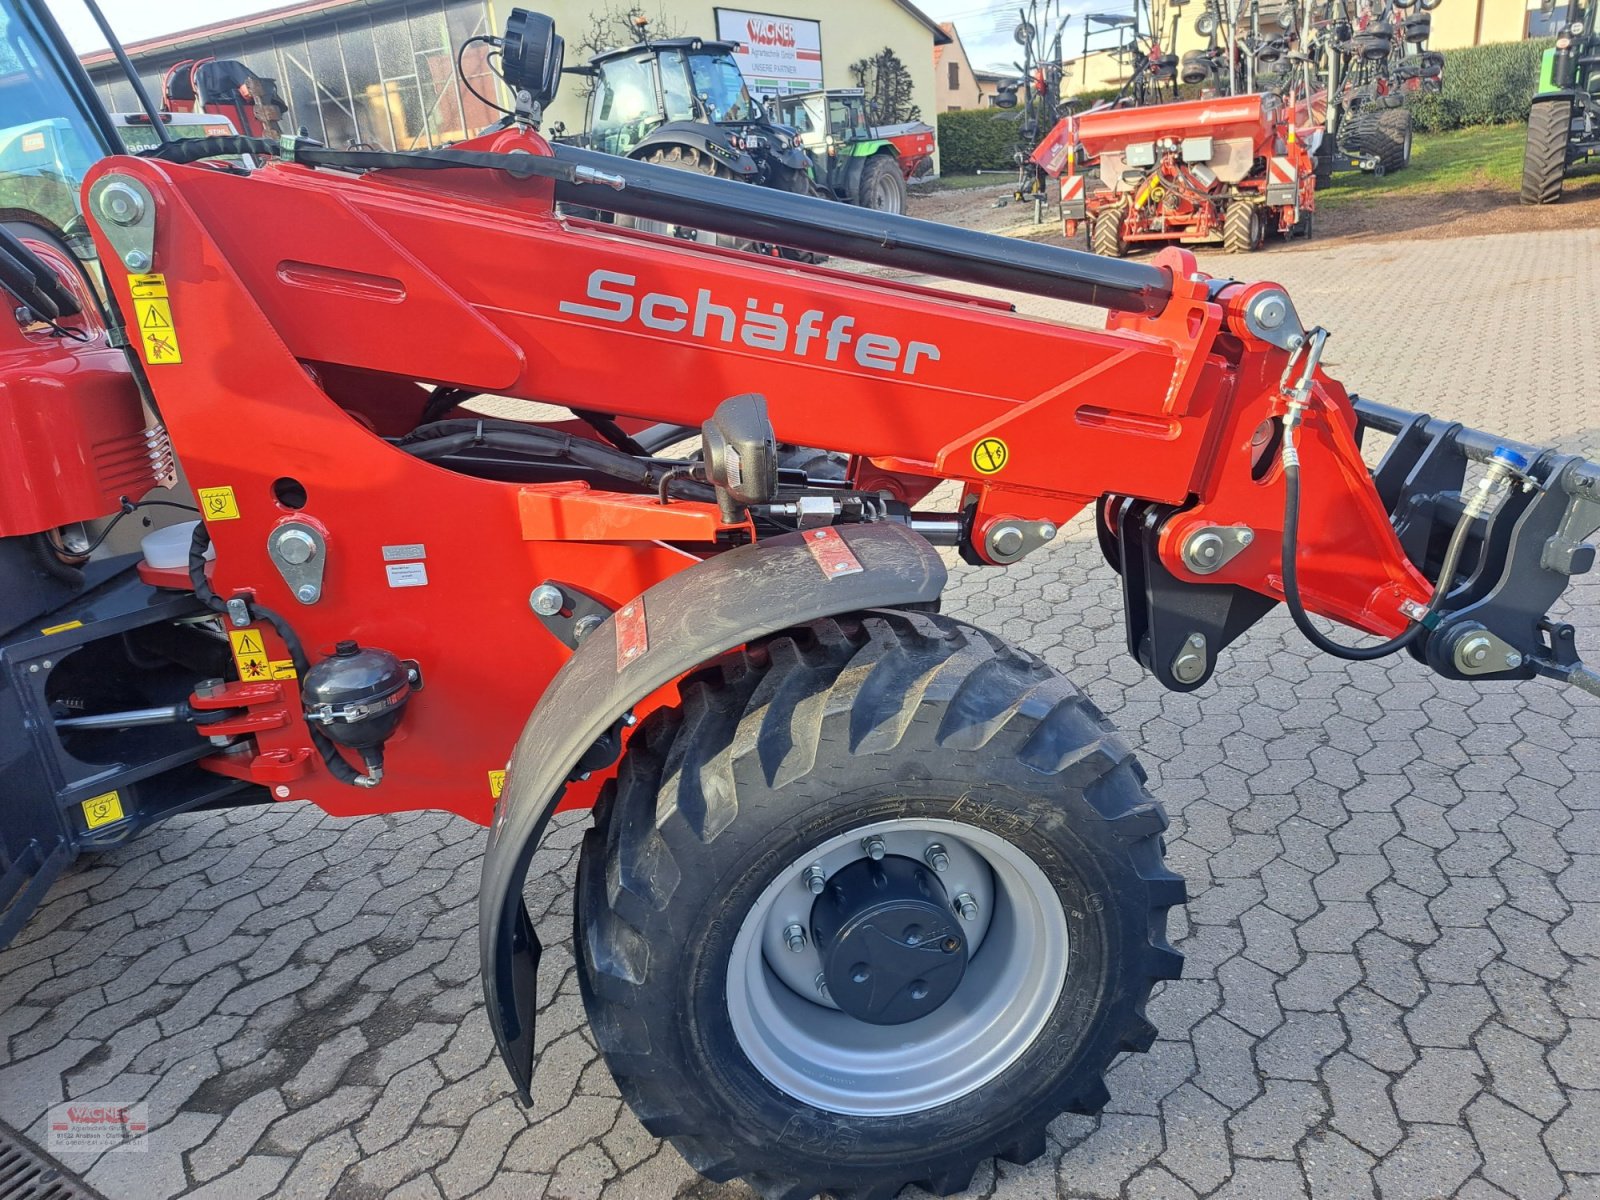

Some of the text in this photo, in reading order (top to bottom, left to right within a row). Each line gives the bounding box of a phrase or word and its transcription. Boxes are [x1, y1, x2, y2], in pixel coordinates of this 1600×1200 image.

[746, 18, 795, 48] WAGNER
[751, 63, 797, 74] UNSERE PARTNER
[559, 269, 941, 375] Schäffer
